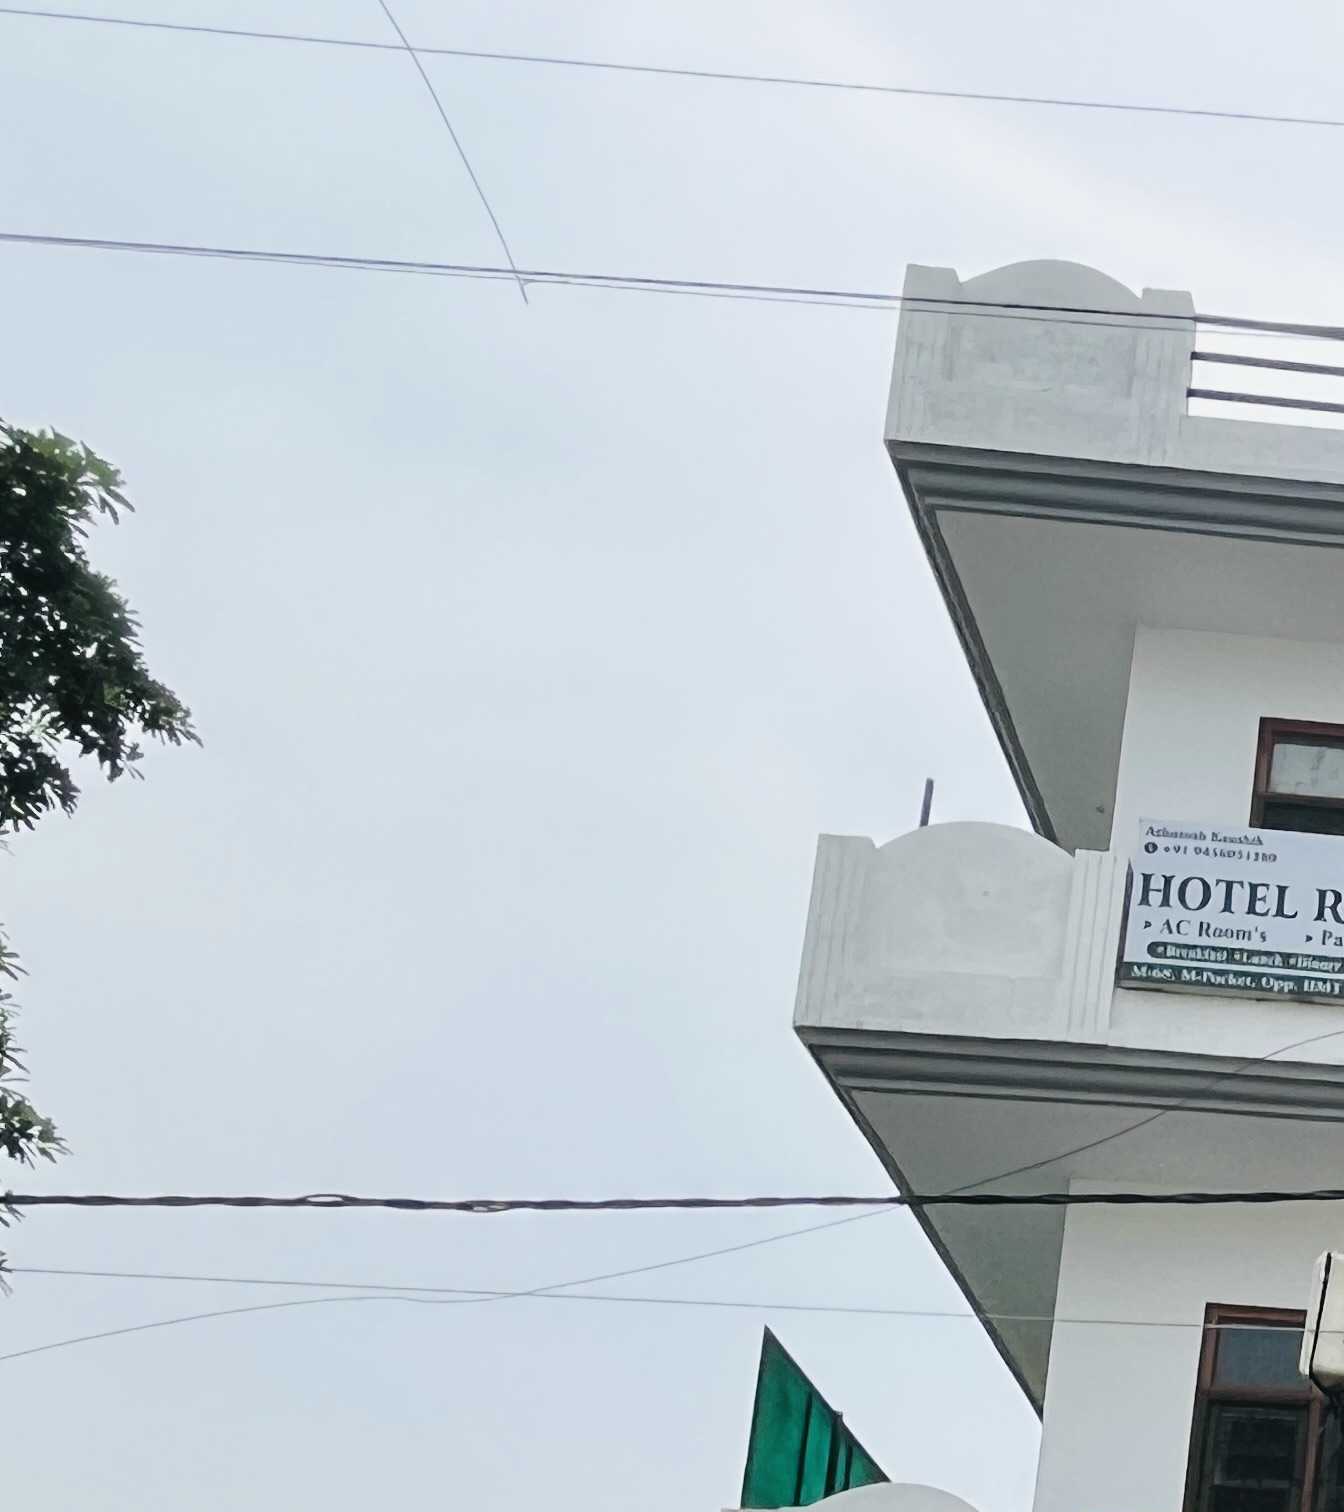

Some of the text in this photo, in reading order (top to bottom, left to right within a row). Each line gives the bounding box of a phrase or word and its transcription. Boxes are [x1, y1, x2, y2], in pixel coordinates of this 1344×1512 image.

[1137, 872, 1298, 920] HOTEL
[1160, 918, 1191, 936] AC
[1198, 920, 1267, 943] Room's
